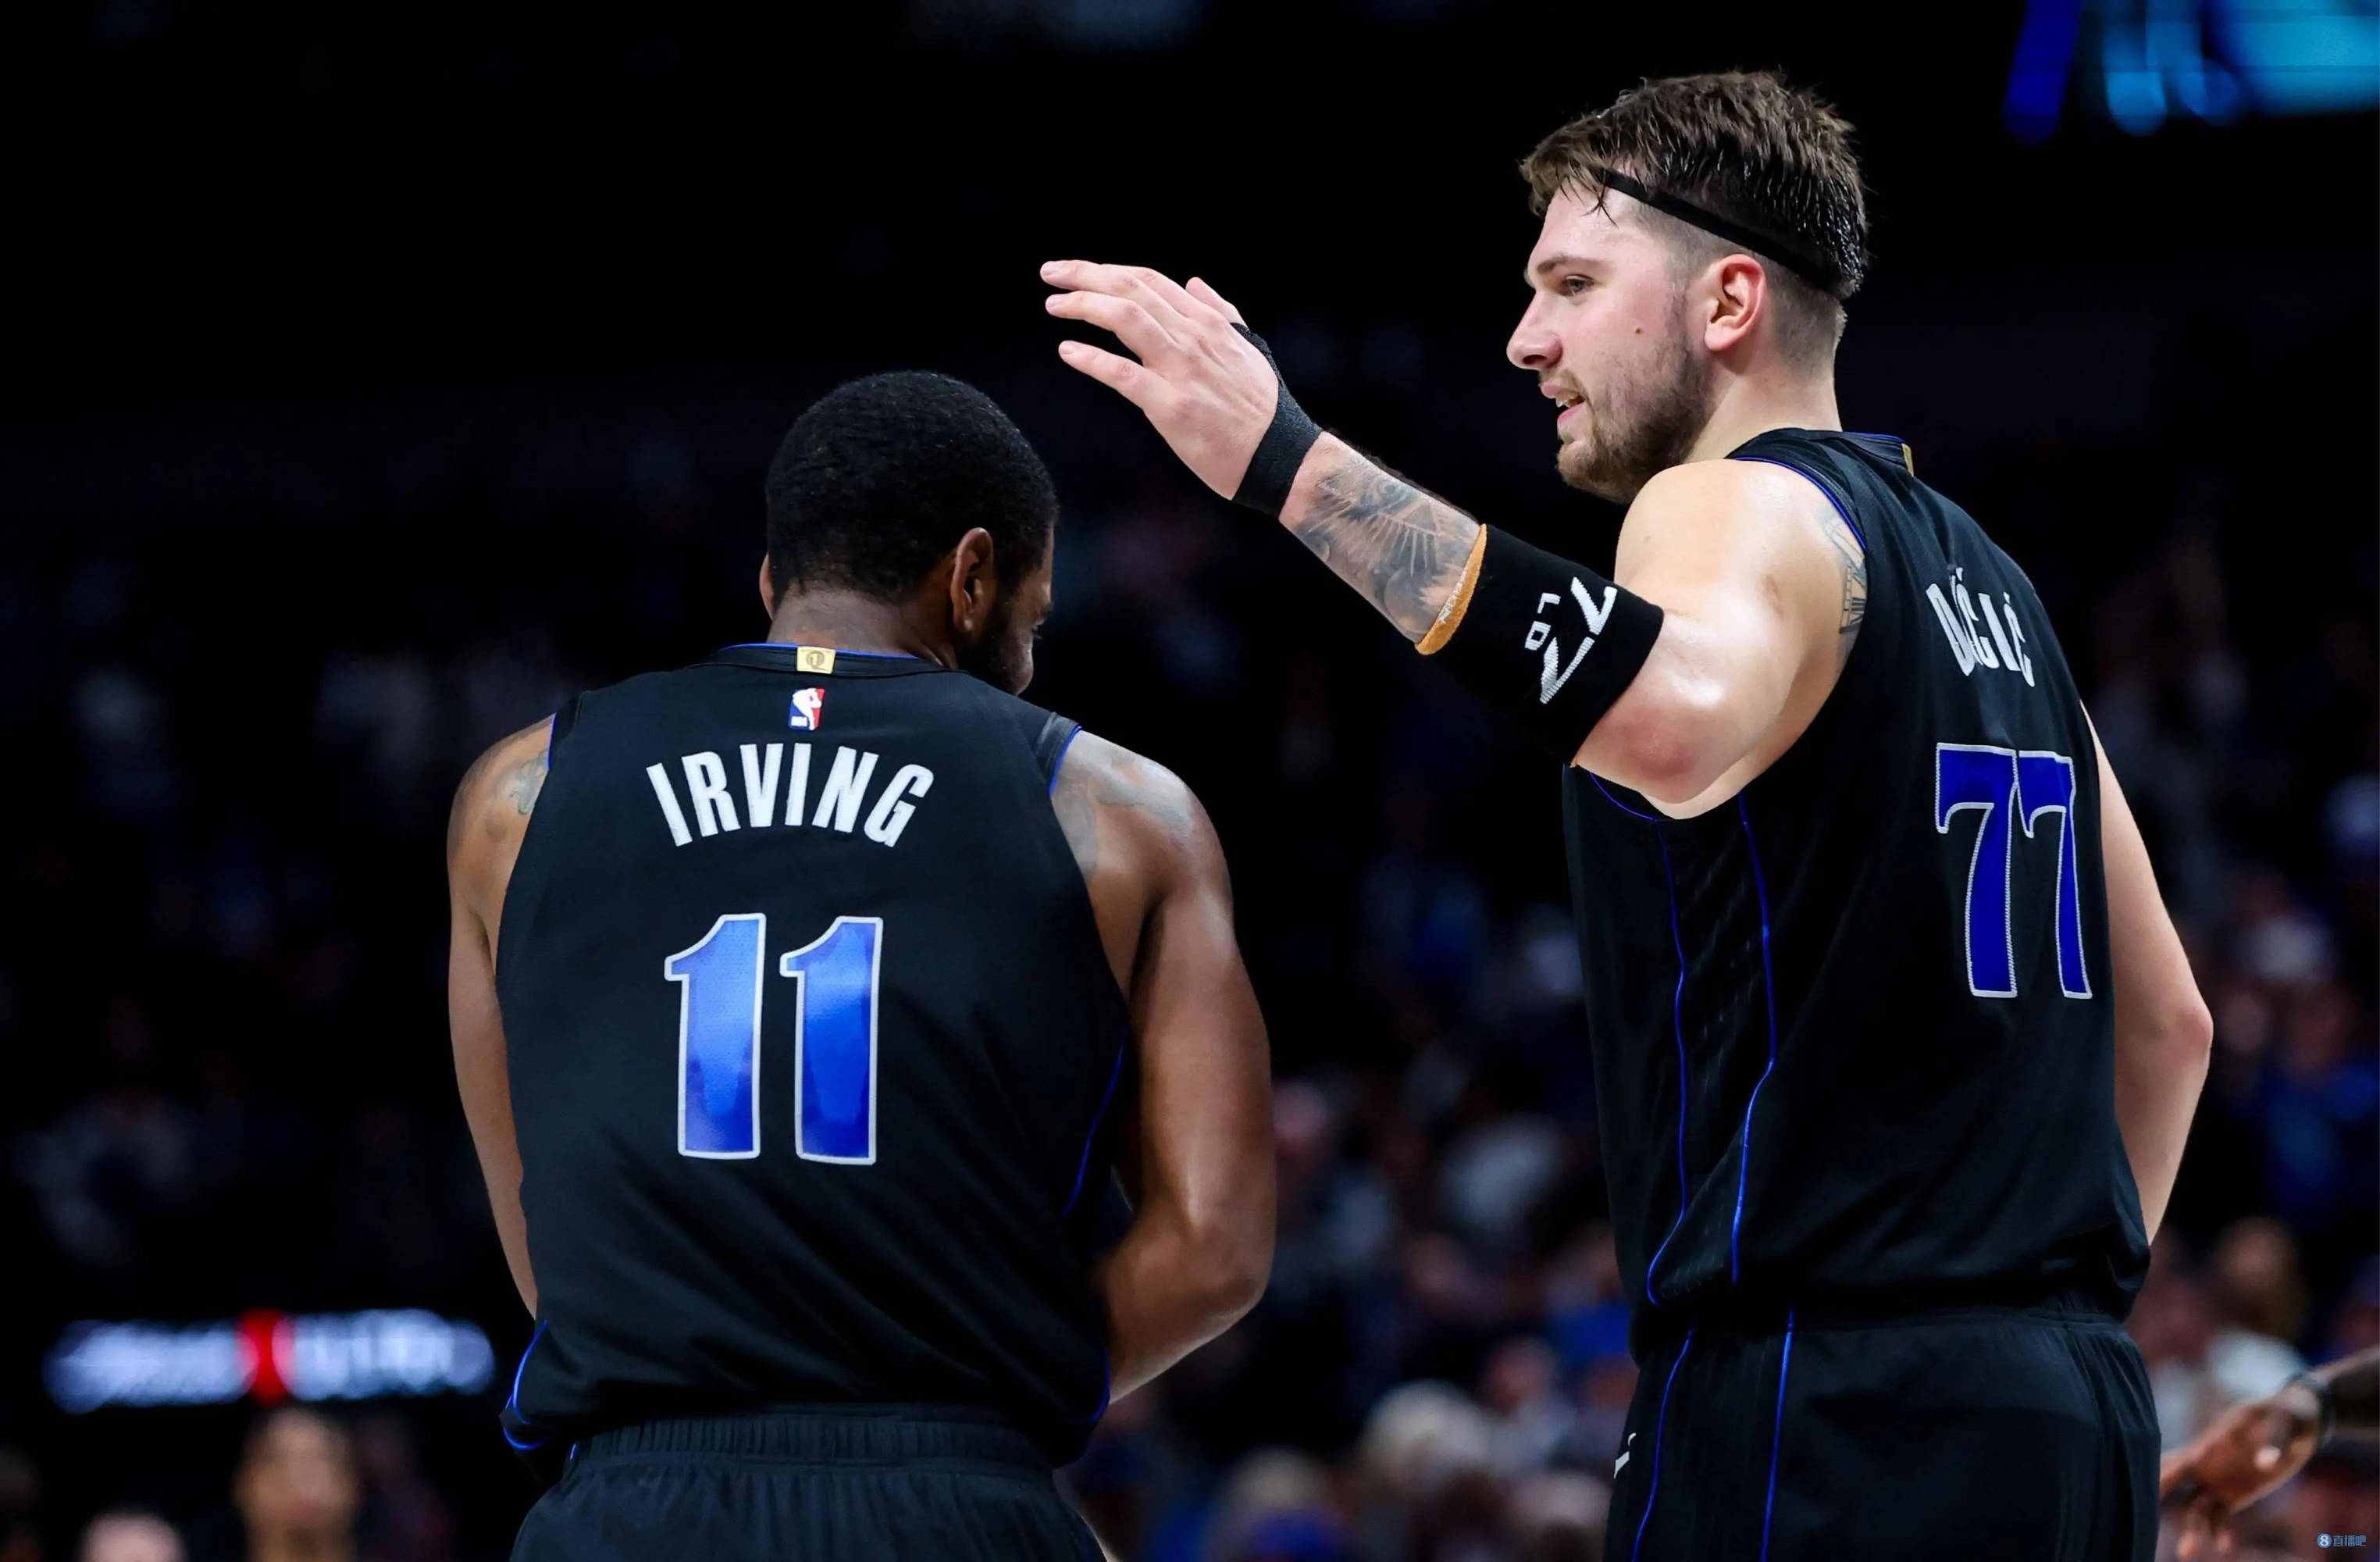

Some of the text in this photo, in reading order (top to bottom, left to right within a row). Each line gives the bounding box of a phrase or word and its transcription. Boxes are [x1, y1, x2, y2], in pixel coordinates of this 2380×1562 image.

[647, 743, 934, 847] IRVING
[1935, 743, 2093, 1000] 77
[664, 912, 884, 1165] 11
